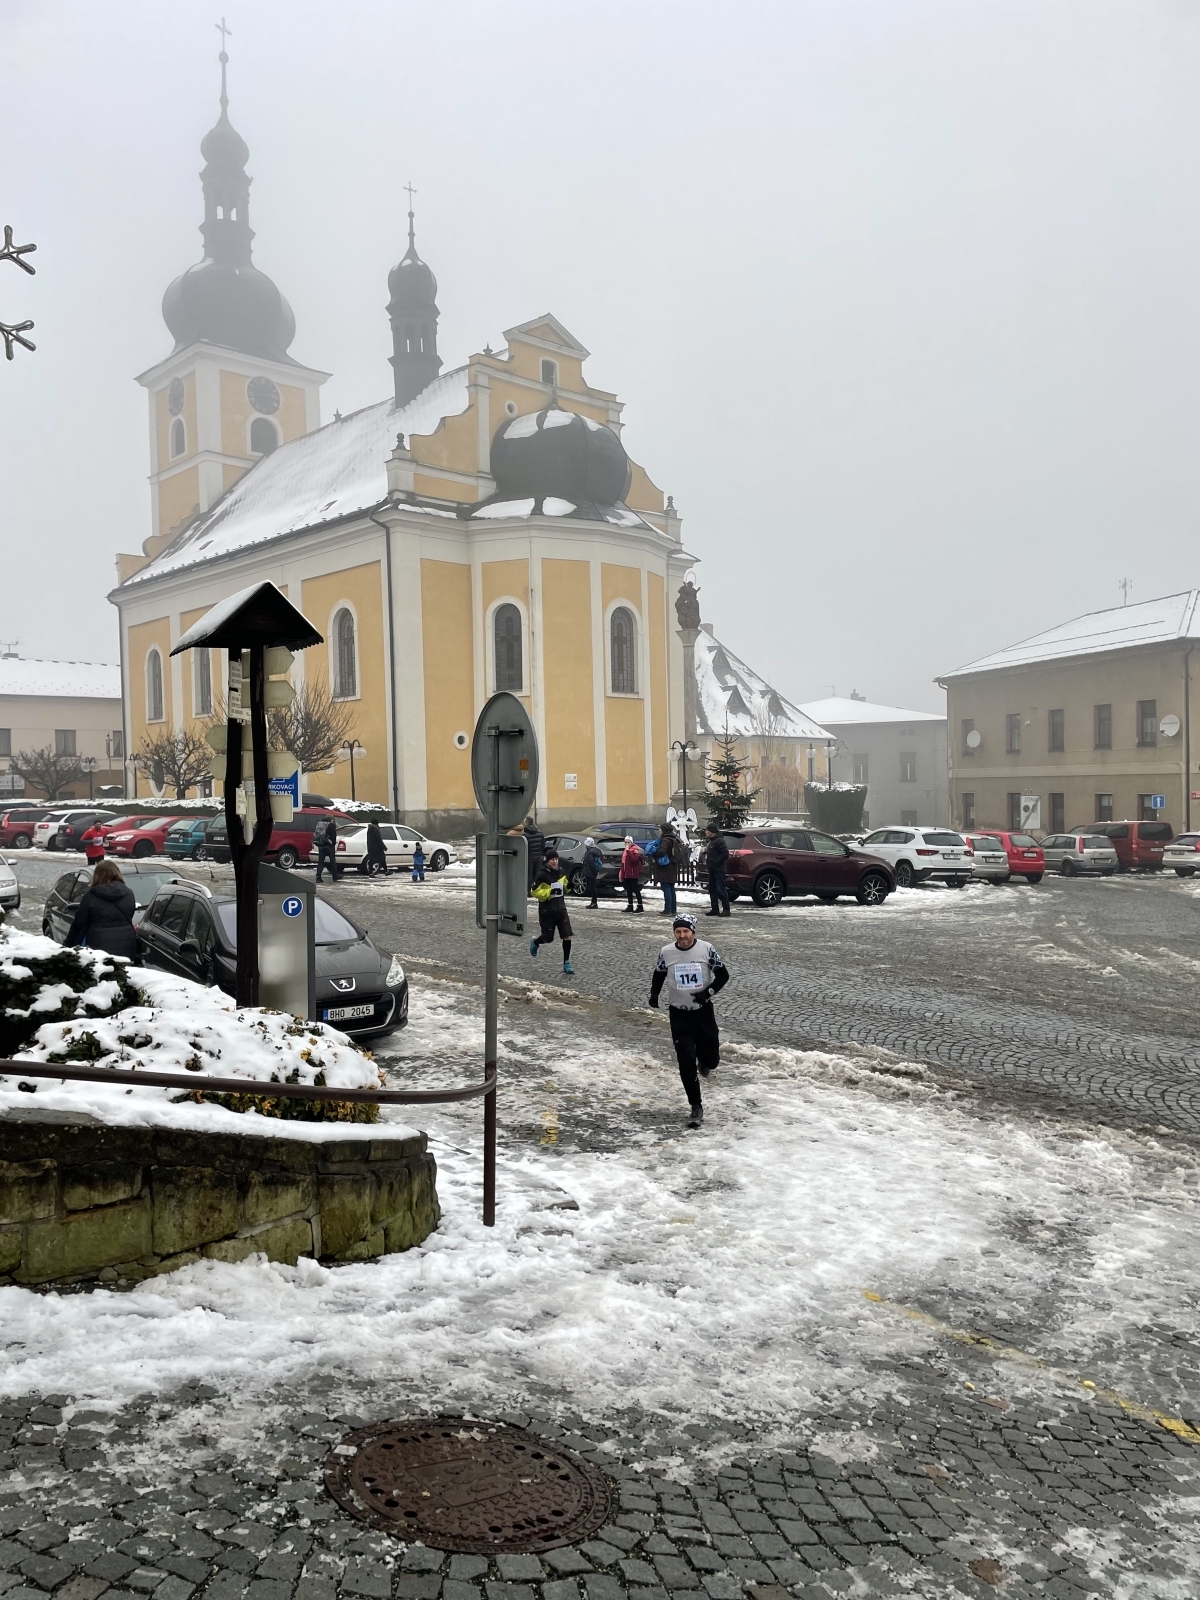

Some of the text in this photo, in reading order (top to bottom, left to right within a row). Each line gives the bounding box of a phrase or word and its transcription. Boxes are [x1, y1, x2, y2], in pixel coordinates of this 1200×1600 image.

[288, 901, 298, 913] P
[679, 974, 698, 984] 114
[351, 1006, 370, 1016] 2045
